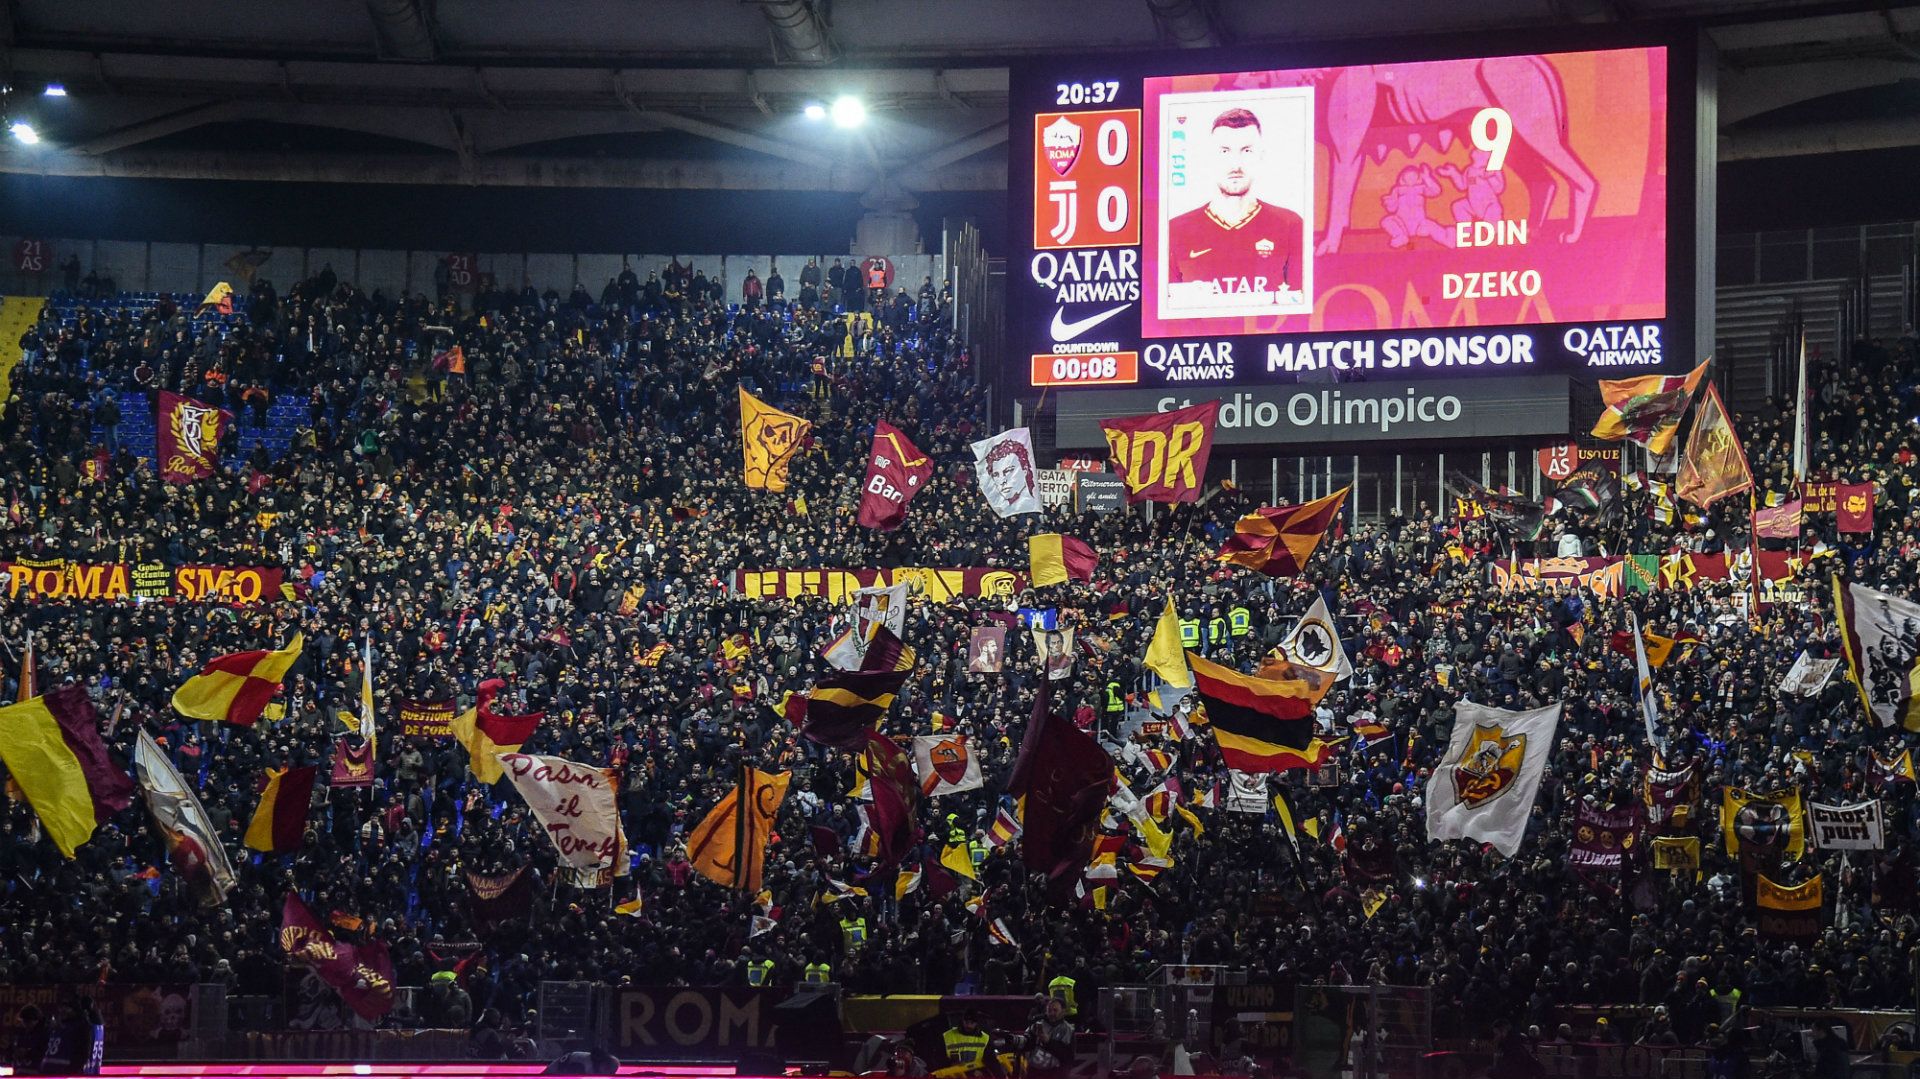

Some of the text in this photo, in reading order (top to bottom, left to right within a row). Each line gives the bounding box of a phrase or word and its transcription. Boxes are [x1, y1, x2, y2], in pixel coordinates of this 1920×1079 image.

[1056, 82, 1120, 105] 20:37
[1097, 119, 1129, 166] 0
[1471, 107, 1513, 172] 9
[1049, 150, 1075, 160] ROMA
[1097, 186, 1129, 232] 0
[1455, 219, 1528, 248] EDIN
[23, 240, 41, 256] 21
[21, 256, 42, 271] AS
[451, 255, 469, 270] 21
[1031, 249, 1139, 290] QATAR
[1056, 281, 1140, 303] AIRWAYS
[1442, 269, 1542, 299] DZEKO
[1052, 342, 1119, 354] COUNTDOWN
[1563, 326, 1661, 354] QATAR
[1144, 341, 1234, 371] QATAR
[1266, 334, 1534, 372] MATCH SPONSOR
[1588, 348, 1662, 367] AIRWAYS
[1052, 357, 1117, 380] 00:08
[1166, 365, 1234, 381] AIRWAYS
[1287, 389, 1462, 432] Olimpico
[1547, 459, 1570, 475] AS
[400, 710, 455, 721] QUESTIONE
[404, 724, 453, 736] DE CORE
[555, 794, 583, 818] il
[1815, 805, 1875, 823] Cuori
[1821, 825, 1870, 845] puri
